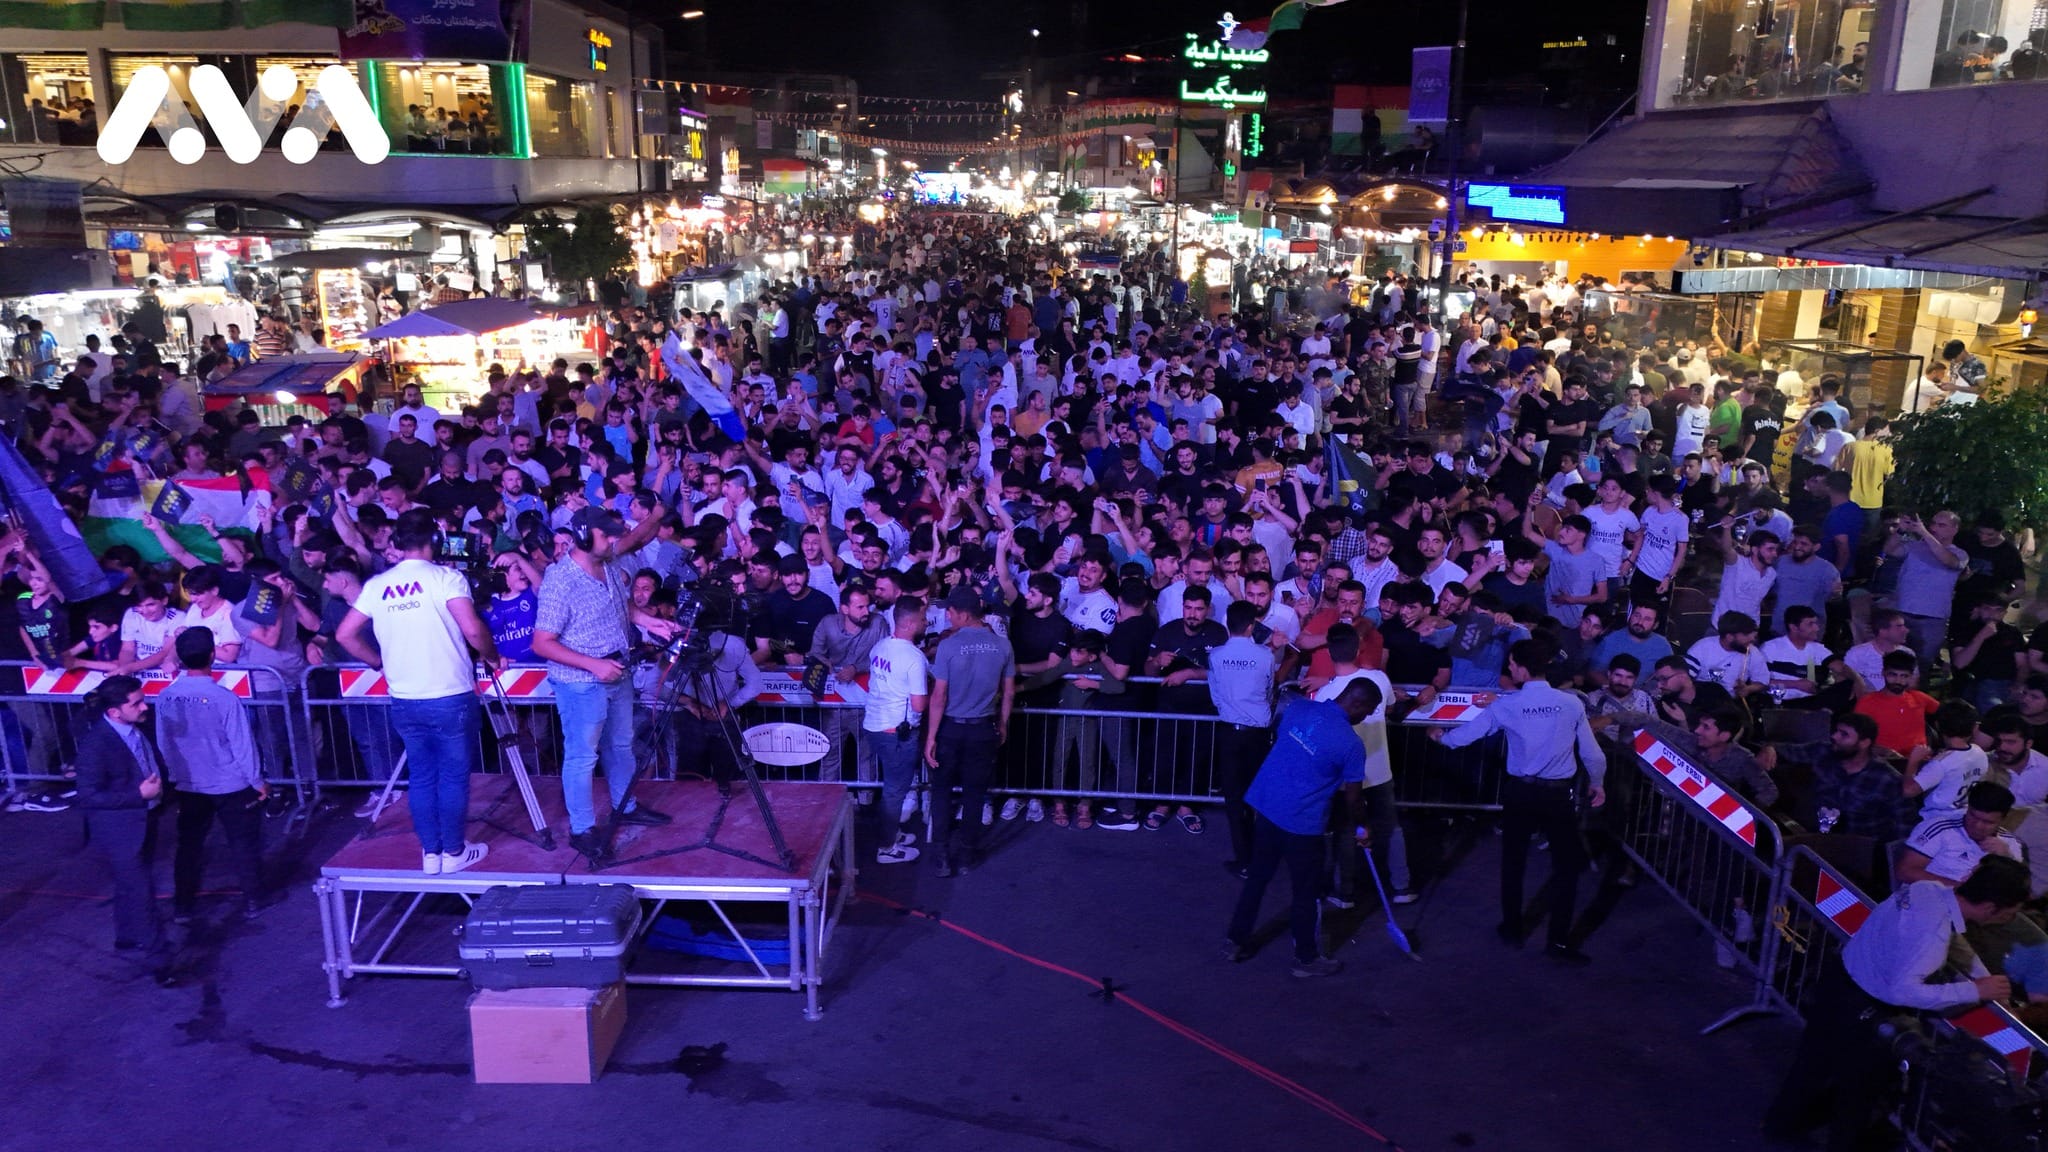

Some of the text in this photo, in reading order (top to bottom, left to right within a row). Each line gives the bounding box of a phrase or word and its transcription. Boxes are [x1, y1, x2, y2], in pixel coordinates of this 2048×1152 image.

[1185, 32, 1270, 70] صيدلية
[381, 581, 424, 601] AVA
[387, 600, 421, 613] media
[1222, 659, 1257, 668] MANDO
[1438, 695, 1469, 704] ERBIL
[1522, 705, 1563, 716] MANDO
[1662, 746, 1704, 784] CITY OF ERBIL
